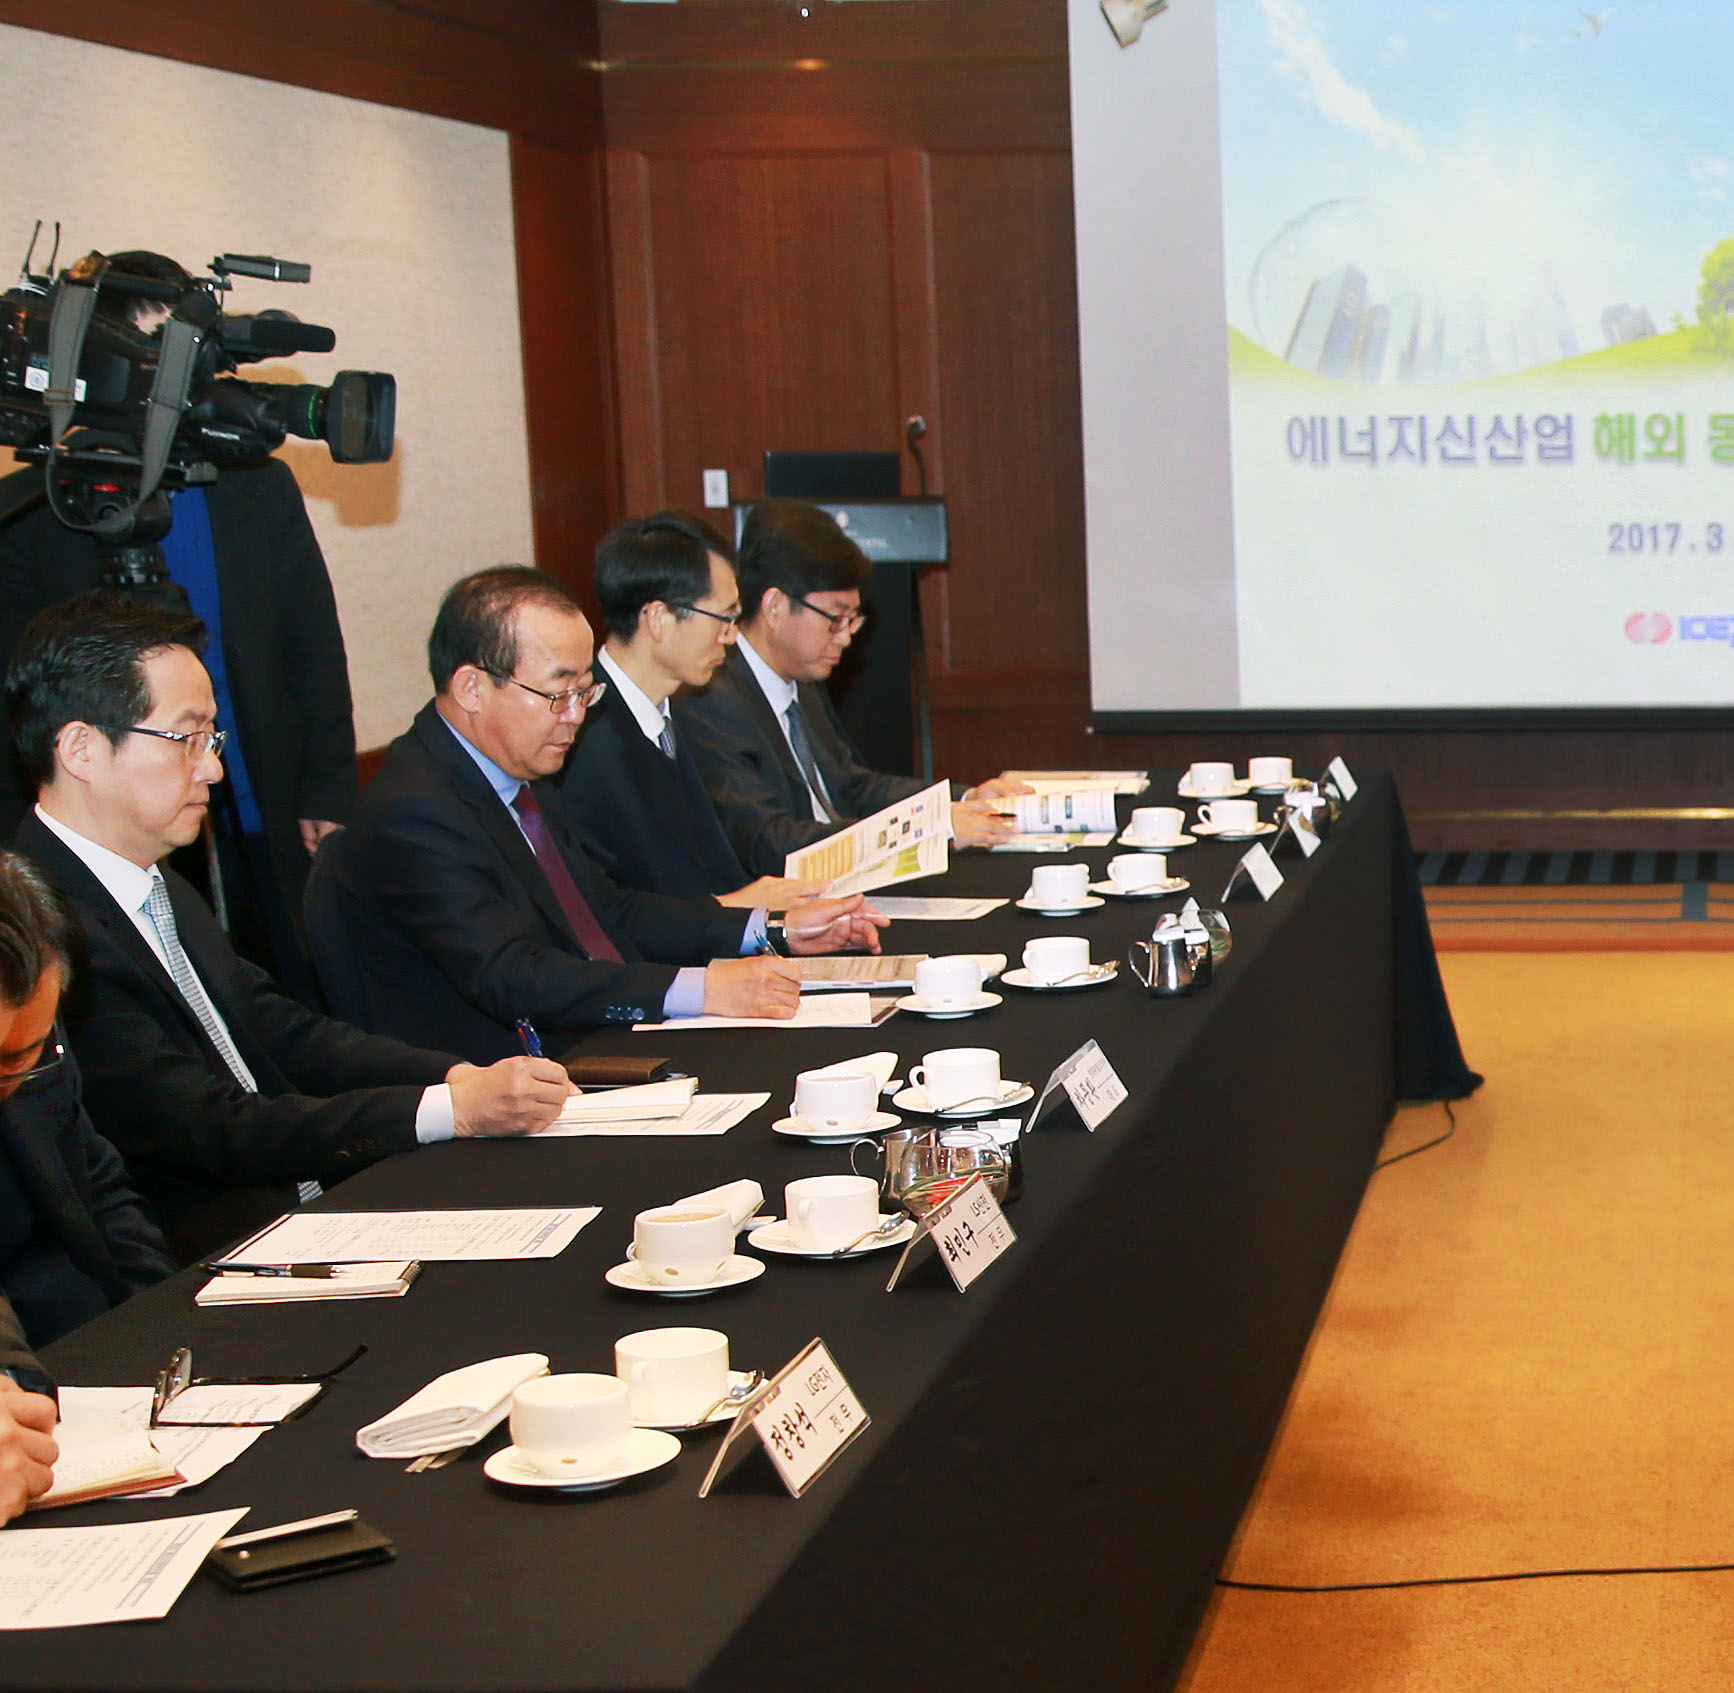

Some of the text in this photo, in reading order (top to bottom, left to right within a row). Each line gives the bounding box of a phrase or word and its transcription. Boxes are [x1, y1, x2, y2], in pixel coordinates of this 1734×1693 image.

[1286, 413, 1573, 464] 에너지신산업
[1593, 412, 1686, 463] 해외
[805, 1366, 834, 1396] LG전자
[770, 1402, 819, 1460] 정창석
